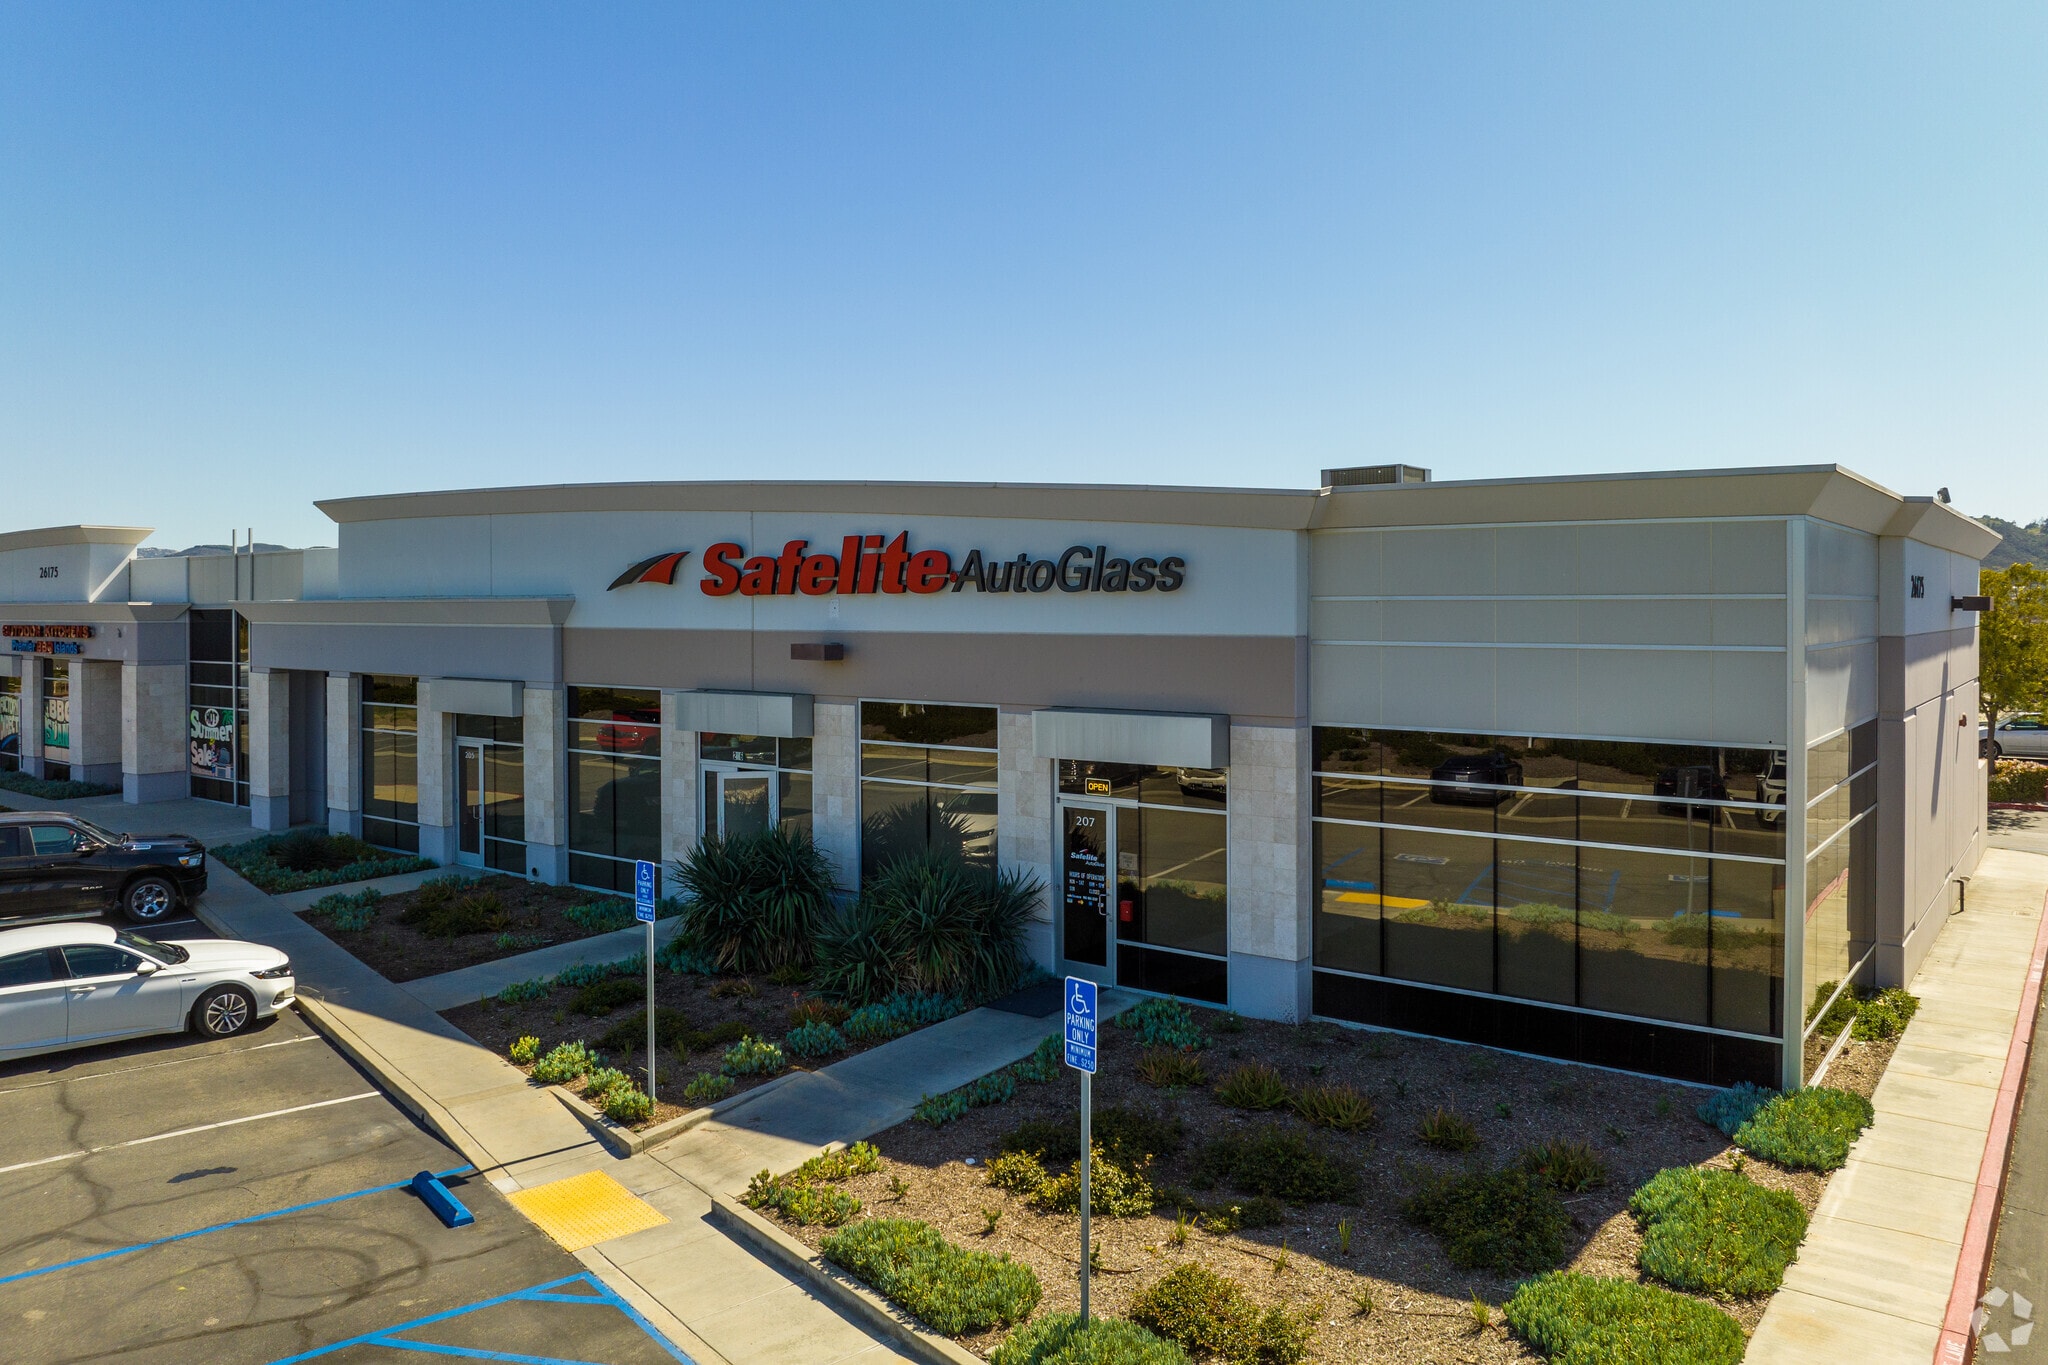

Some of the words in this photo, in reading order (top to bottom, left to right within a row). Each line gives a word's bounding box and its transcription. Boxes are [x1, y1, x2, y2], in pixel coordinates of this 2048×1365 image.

[700, 530, 951, 597] Safelite
[951, 545, 1185, 595] AutoGlass
[39, 566, 58, 579] 26175
[191, 709, 233, 742] Summer
[191, 740, 213, 766] Sale
[1088, 782, 1109, 792] OPEN
[1076, 816, 1095, 827] 207
[1067, 1012, 1095, 1032] PARKING
[1072, 1027, 1089, 1044] ONLY
[1070, 1044, 1091, 1057] MINIMUM
[1067, 1053, 1078, 1065] FINE
[1081, 1058, 1095, 1070] $250
